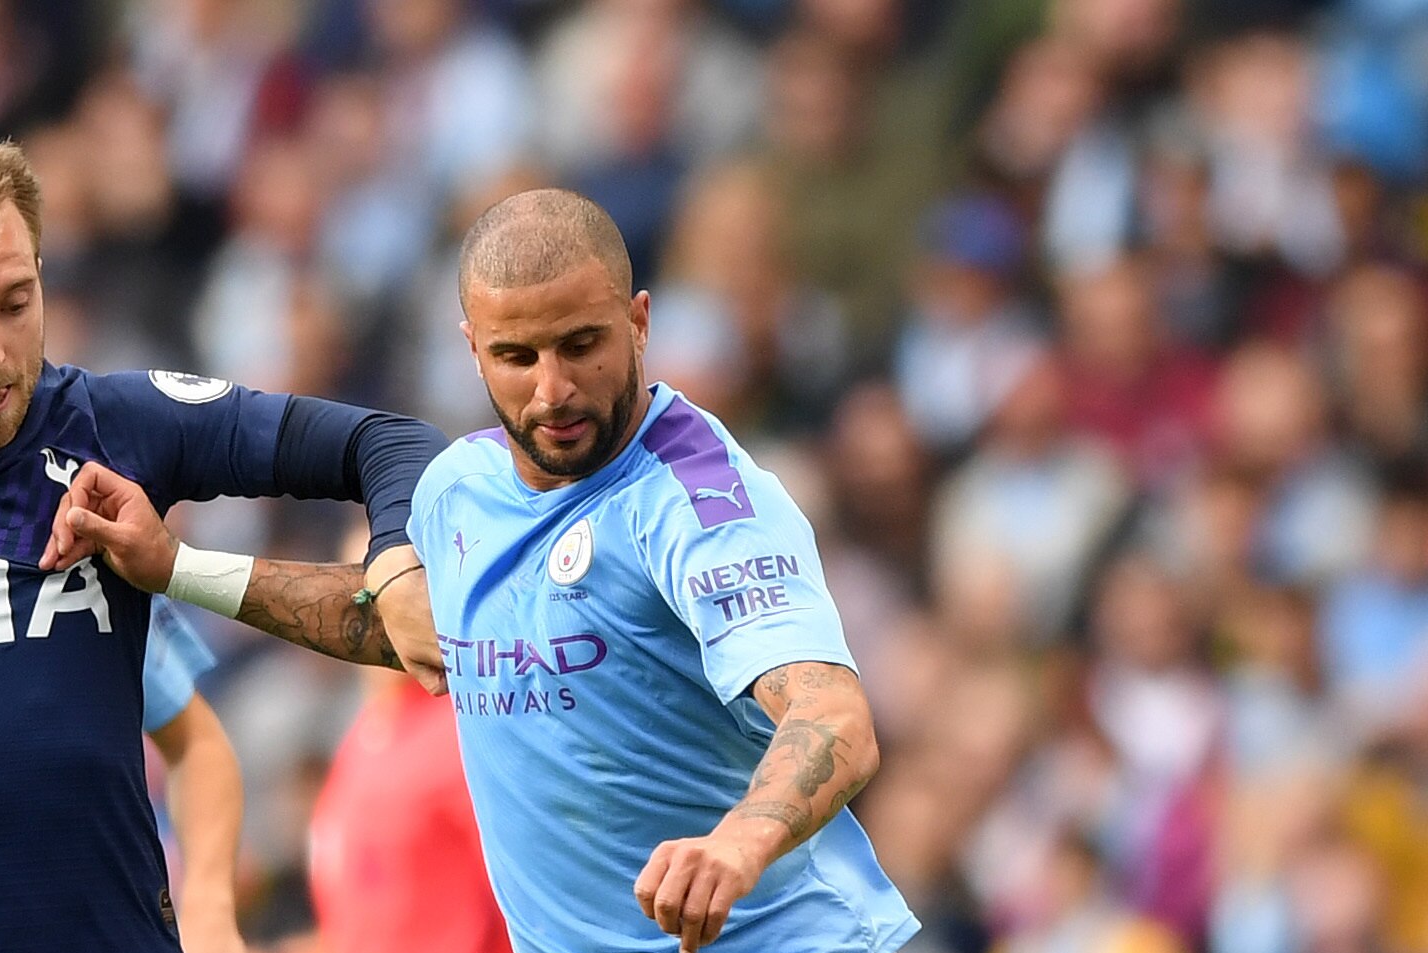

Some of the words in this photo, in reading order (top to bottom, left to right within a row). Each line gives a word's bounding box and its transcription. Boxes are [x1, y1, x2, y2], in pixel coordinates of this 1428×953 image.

[687, 554, 800, 598] NEXEN
[713, 585, 790, 622] TIRE
[455, 688, 577, 715] AIRWAYS
